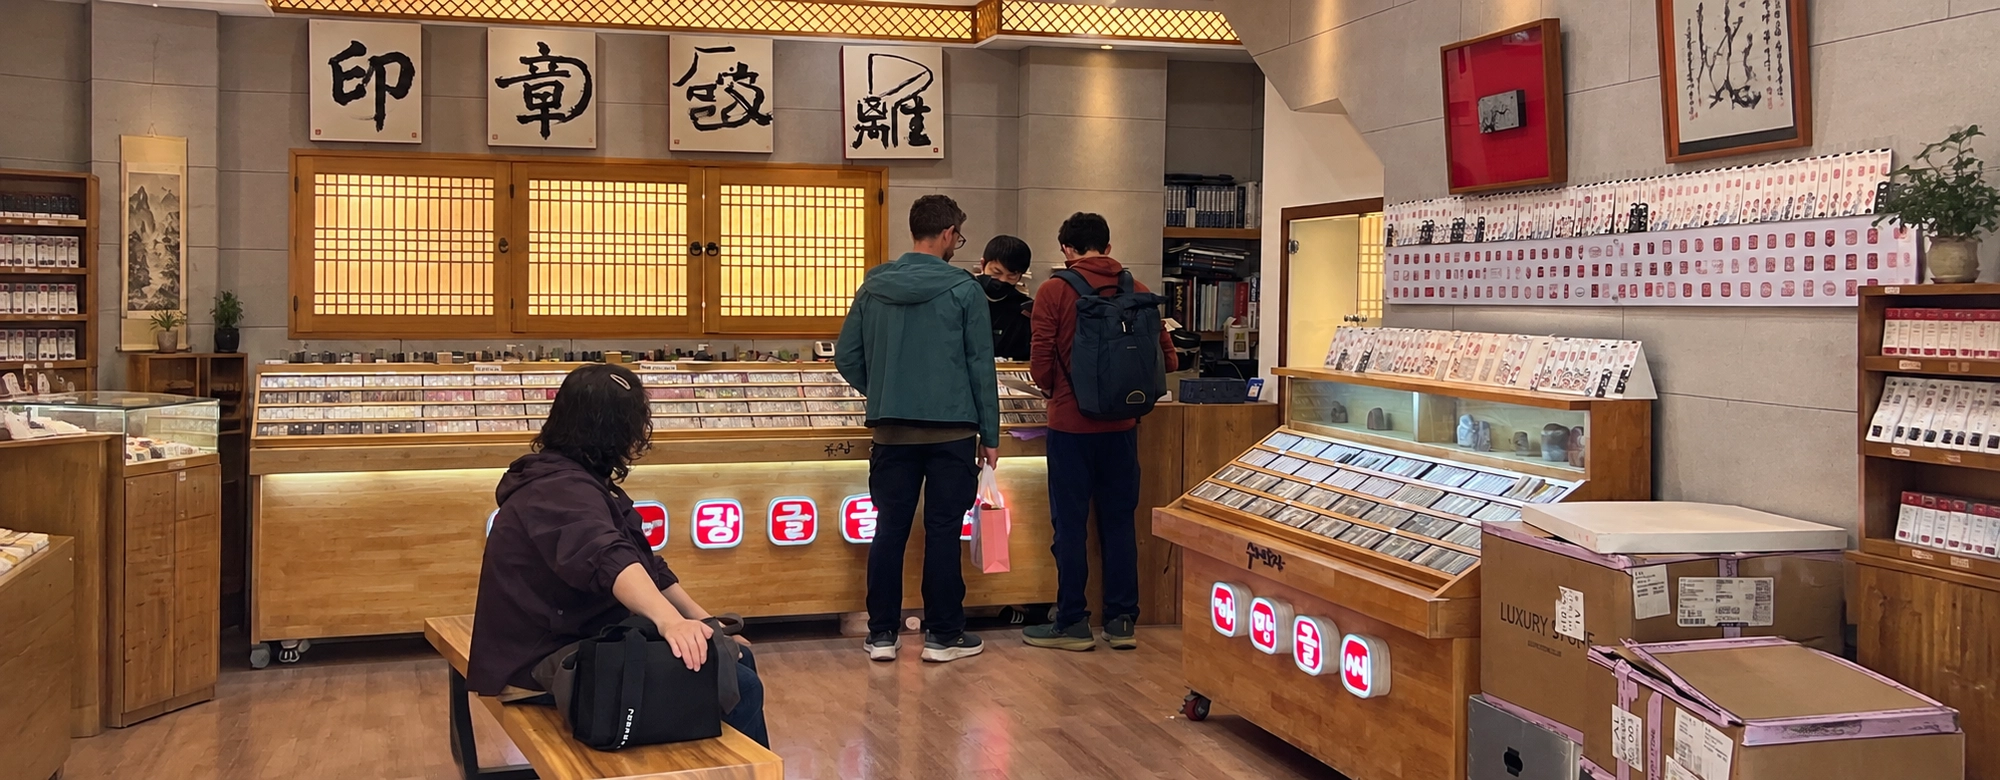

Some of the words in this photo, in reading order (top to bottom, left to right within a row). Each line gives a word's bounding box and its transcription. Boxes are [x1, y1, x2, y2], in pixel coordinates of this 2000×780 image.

[328, 40, 416, 132] 印
[495, 42, 592, 140] 章
[699, 507, 738, 543] 장
[1500, 602, 1548, 637] LUXURY
